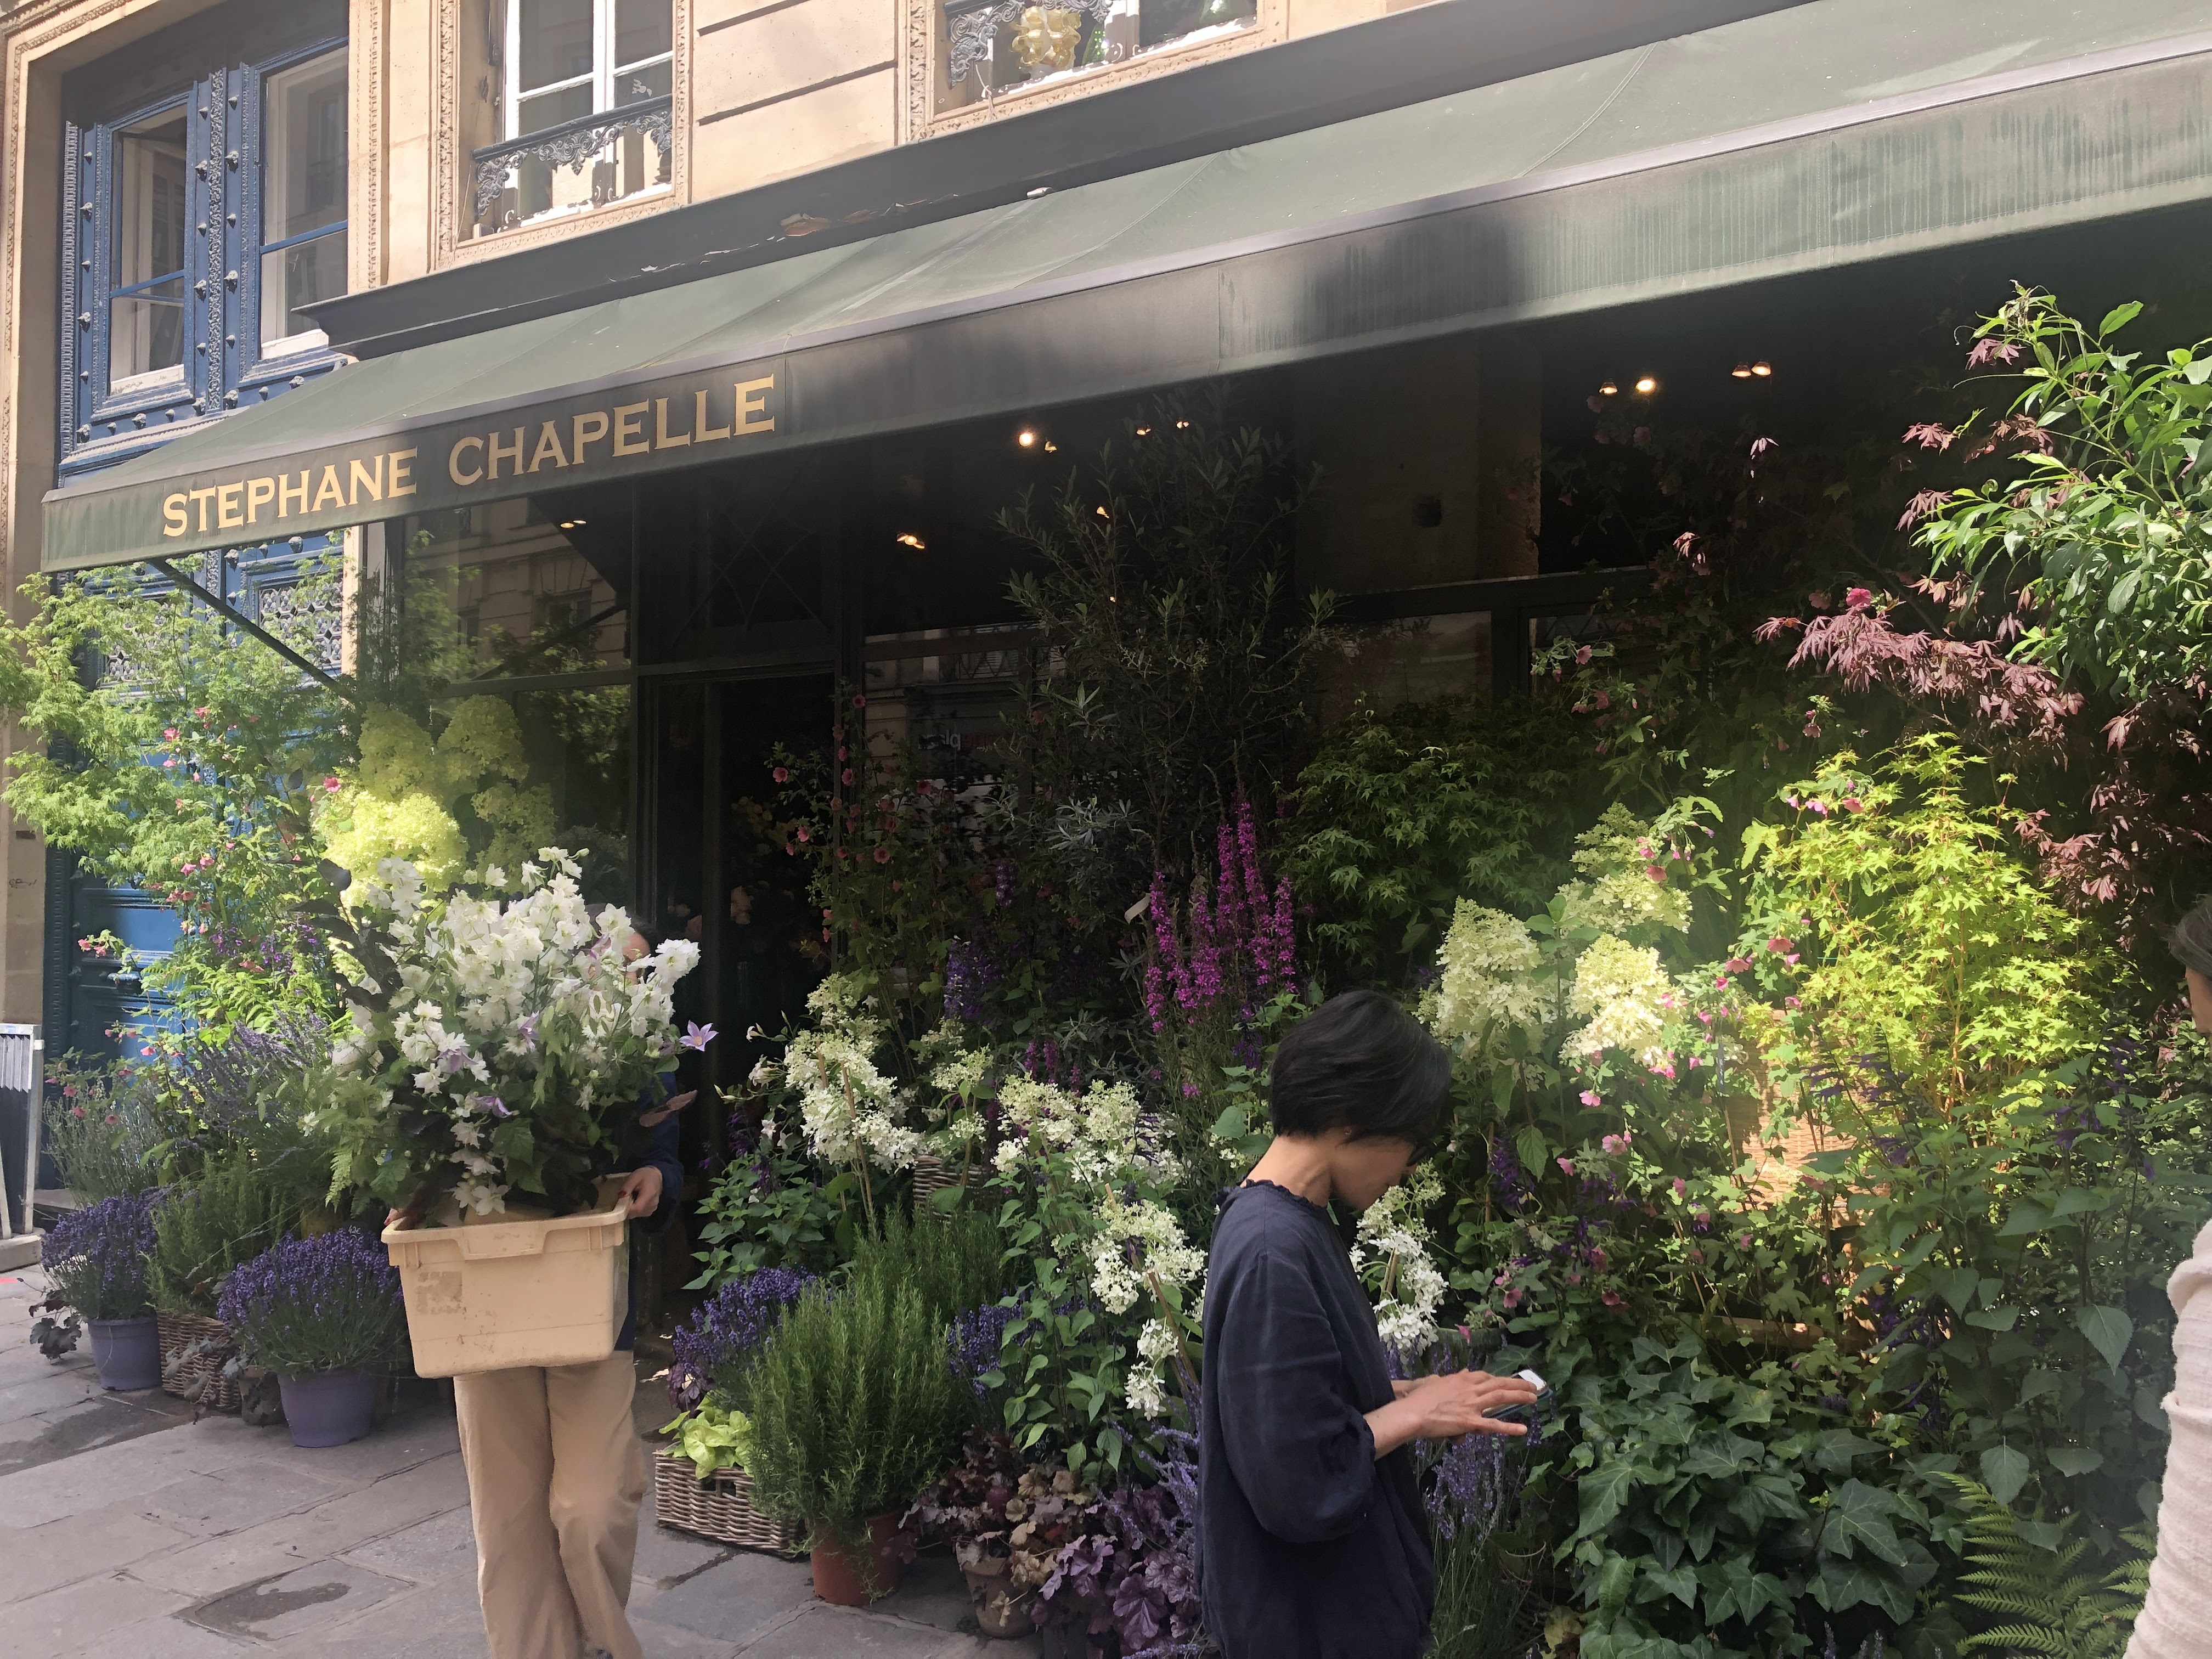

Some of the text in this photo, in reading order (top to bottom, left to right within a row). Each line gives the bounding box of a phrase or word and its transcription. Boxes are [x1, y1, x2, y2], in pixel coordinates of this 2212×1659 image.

[162, 373, 776, 538] STEPHANE CHAPELLE
[348, 1224, 361, 1234] 42€
